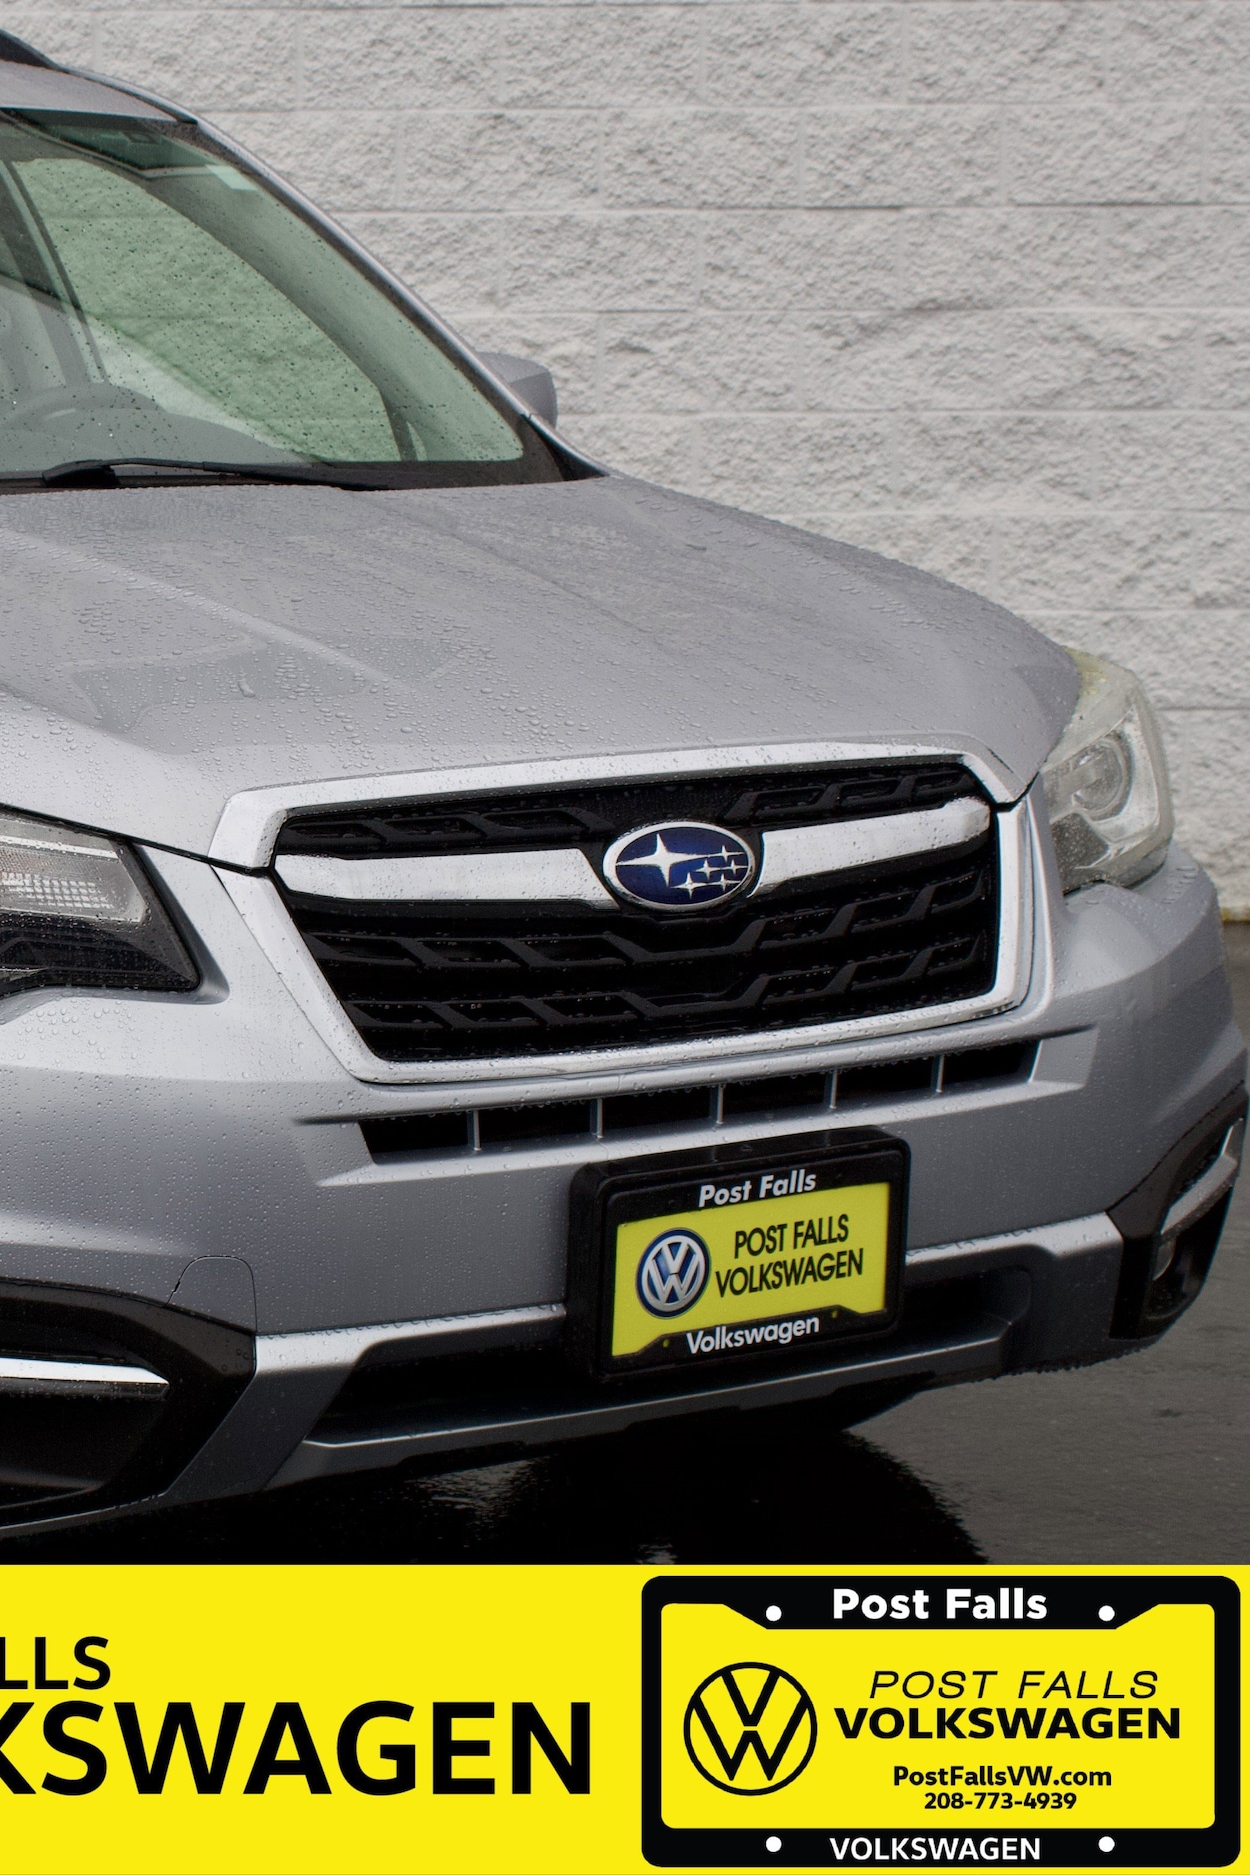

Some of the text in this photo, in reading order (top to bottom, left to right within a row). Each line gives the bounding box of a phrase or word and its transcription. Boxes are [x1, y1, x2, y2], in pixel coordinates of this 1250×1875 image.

[698, 1169, 817, 1208] Post Falls
[734, 1213, 849, 1259] POST FALLS
[715, 1248, 864, 1298] VOLKSWAGEN
[686, 1316, 820, 1354] Volkswagen
